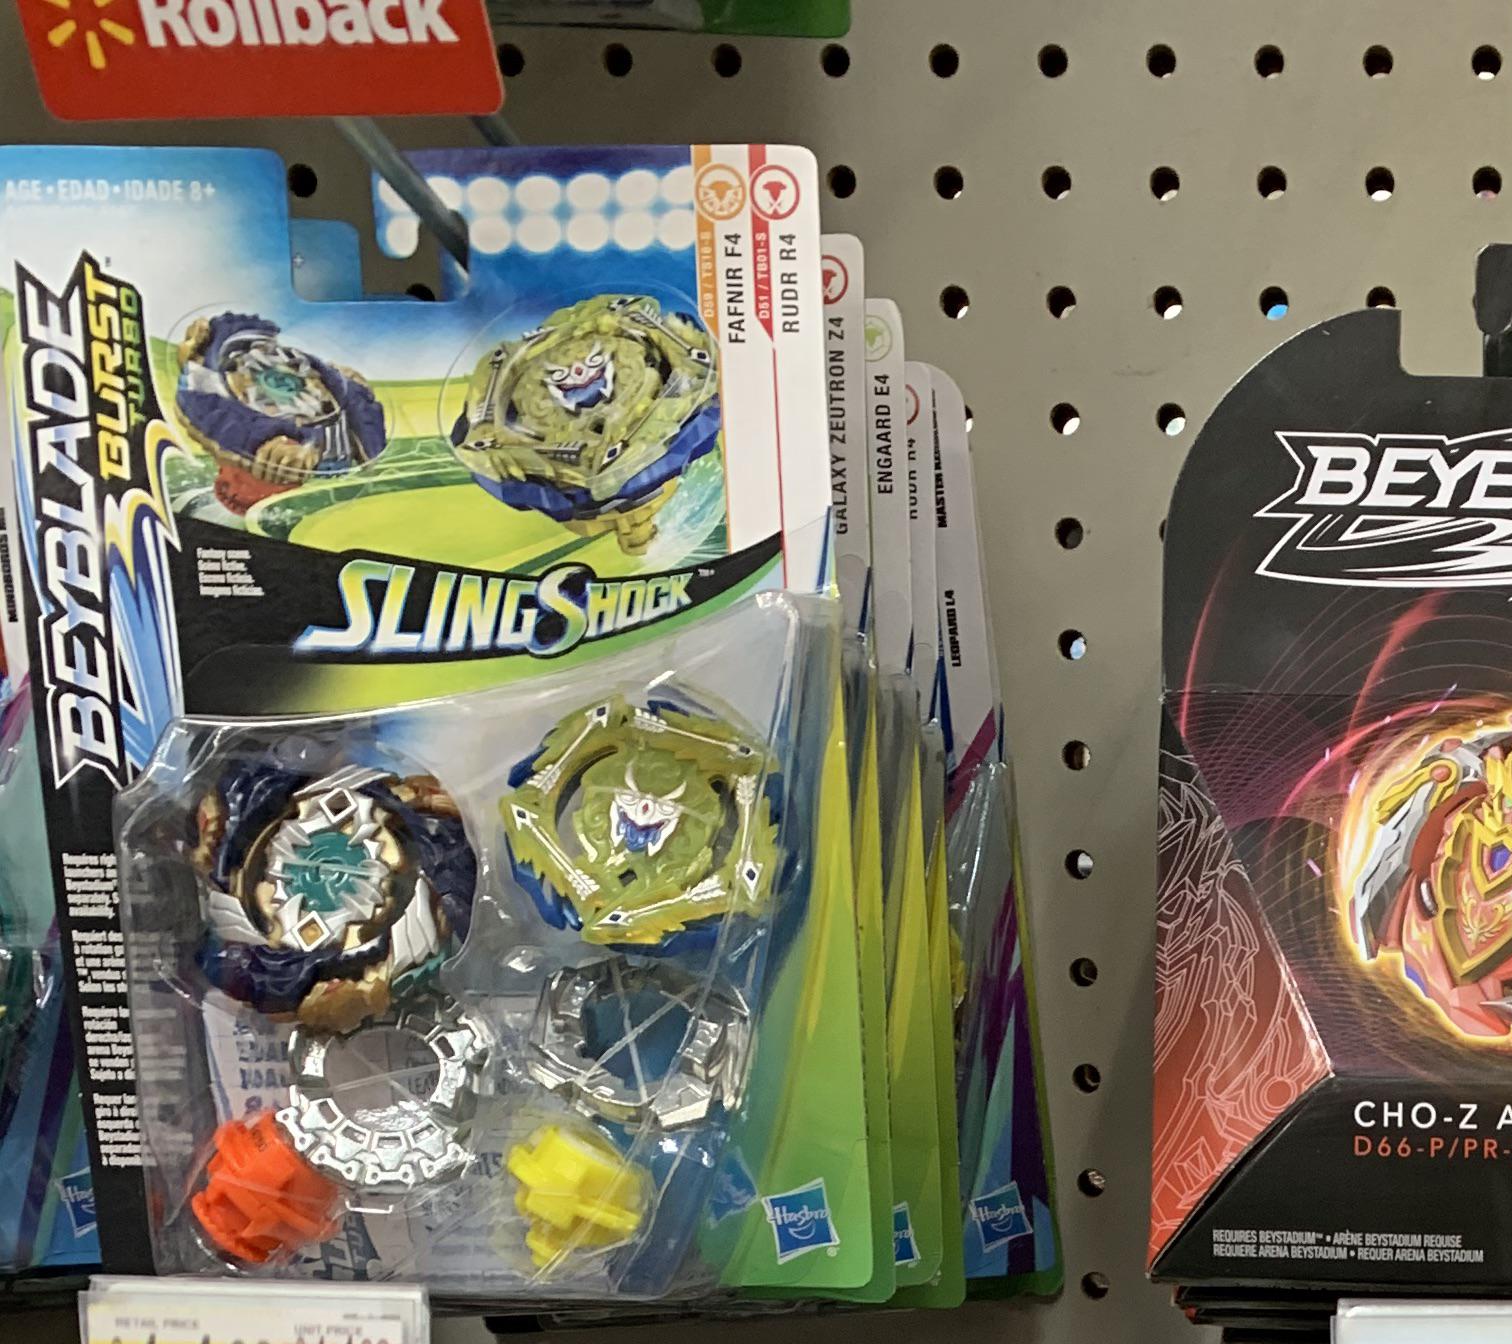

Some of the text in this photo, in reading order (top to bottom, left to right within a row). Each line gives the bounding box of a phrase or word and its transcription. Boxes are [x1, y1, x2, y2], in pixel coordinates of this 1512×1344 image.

[143, 0, 459, 47] Rollback
[725, 233, 745, 343] FAFNIR F4
[780, 233, 799, 333] RUDR R4
[84, 264, 131, 481] BURST
[120, 287, 146, 427] TURBO
[829, 317, 848, 534] GALAXY ZEUTRON Z4
[874, 374, 893, 494] ENGAARD E4
[24, 281, 118, 761] BEYBLADE
[1354, 1101, 1479, 1131] CHO-Z
[767, 1203, 829, 1226] Hasbro
